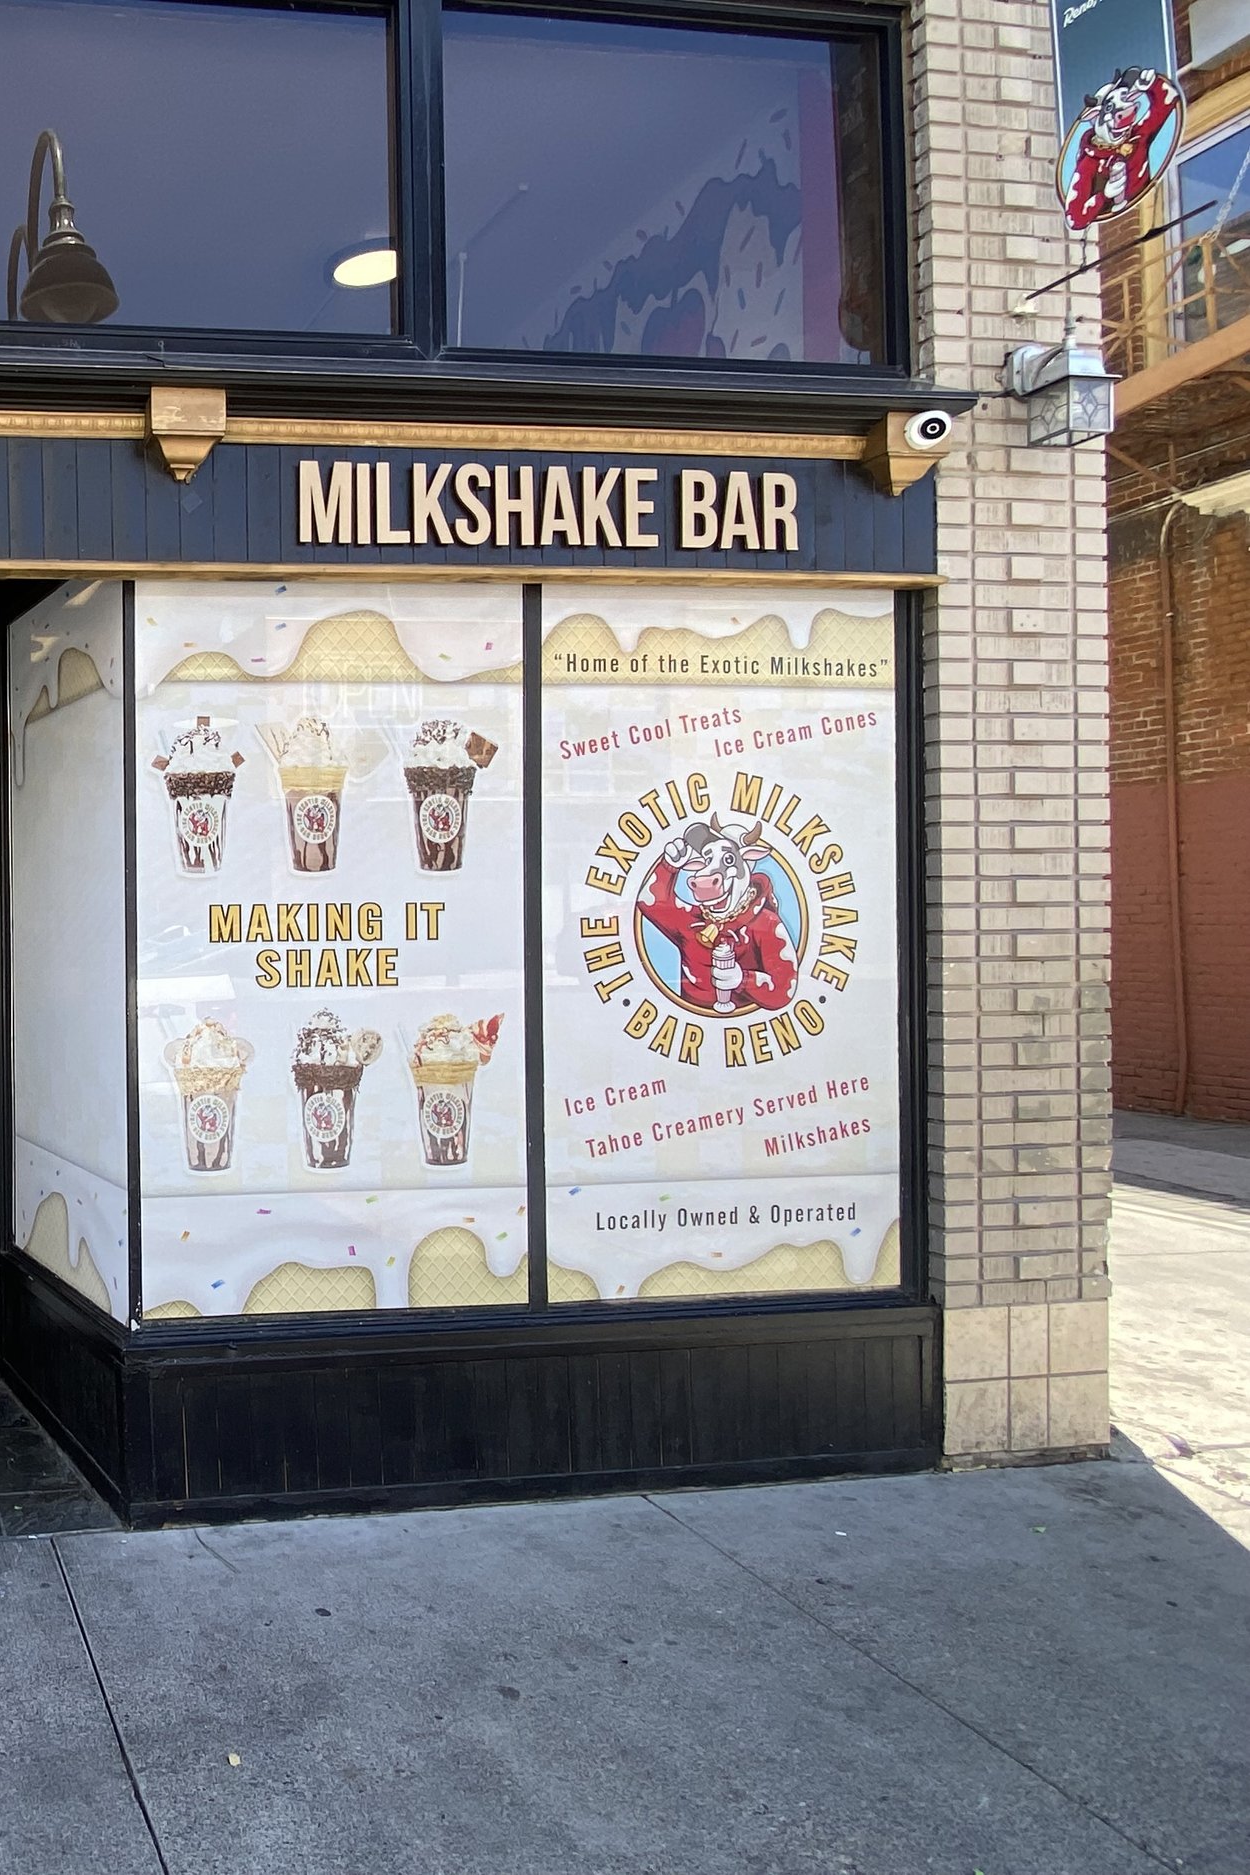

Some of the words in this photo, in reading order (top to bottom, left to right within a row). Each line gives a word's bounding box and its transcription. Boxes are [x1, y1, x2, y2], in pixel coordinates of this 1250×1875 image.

[298, 460, 659, 548] MILKSHAKE
[681, 468, 800, 551] BAR
[630, 654, 648, 673] of
[657, 655, 690, 674] the
[700, 655, 760, 675] Exotic
[559, 730, 620, 760] Sweet
[629, 719, 672, 745] Cool
[679, 707, 743, 734] Treats
[714, 735, 745, 758] Ice
[753, 722, 813, 750] Cream
[821, 710, 878, 736] Cones
[585, 772, 712, 896] EXOTIC
[730, 771, 860, 993] MILKSHAKE
[208, 902, 383, 943] MAKING
[405, 902, 445, 941] IT
[255, 948, 399, 988] SHAKE
[580, 915, 634, 1004] THE
[623, 998, 704, 1066] BAR
[724, 999, 825, 1068] RENO
[564, 1096, 596, 1117] Ice
[604, 1078, 667, 1107] Cream
[585, 1129, 643, 1158] Tahoe
[652, 1105, 745, 1142] Creamery
[753, 1085, 818, 1117] Served
[825, 1076, 870, 1099] Here
[764, 1117, 871, 1158] Milkshakes
[596, 1209, 666, 1231] Locally
[677, 1206, 739, 1227] Owned
[749, 1205, 760, 1224] &
[770, 1202, 857, 1226] Operated
